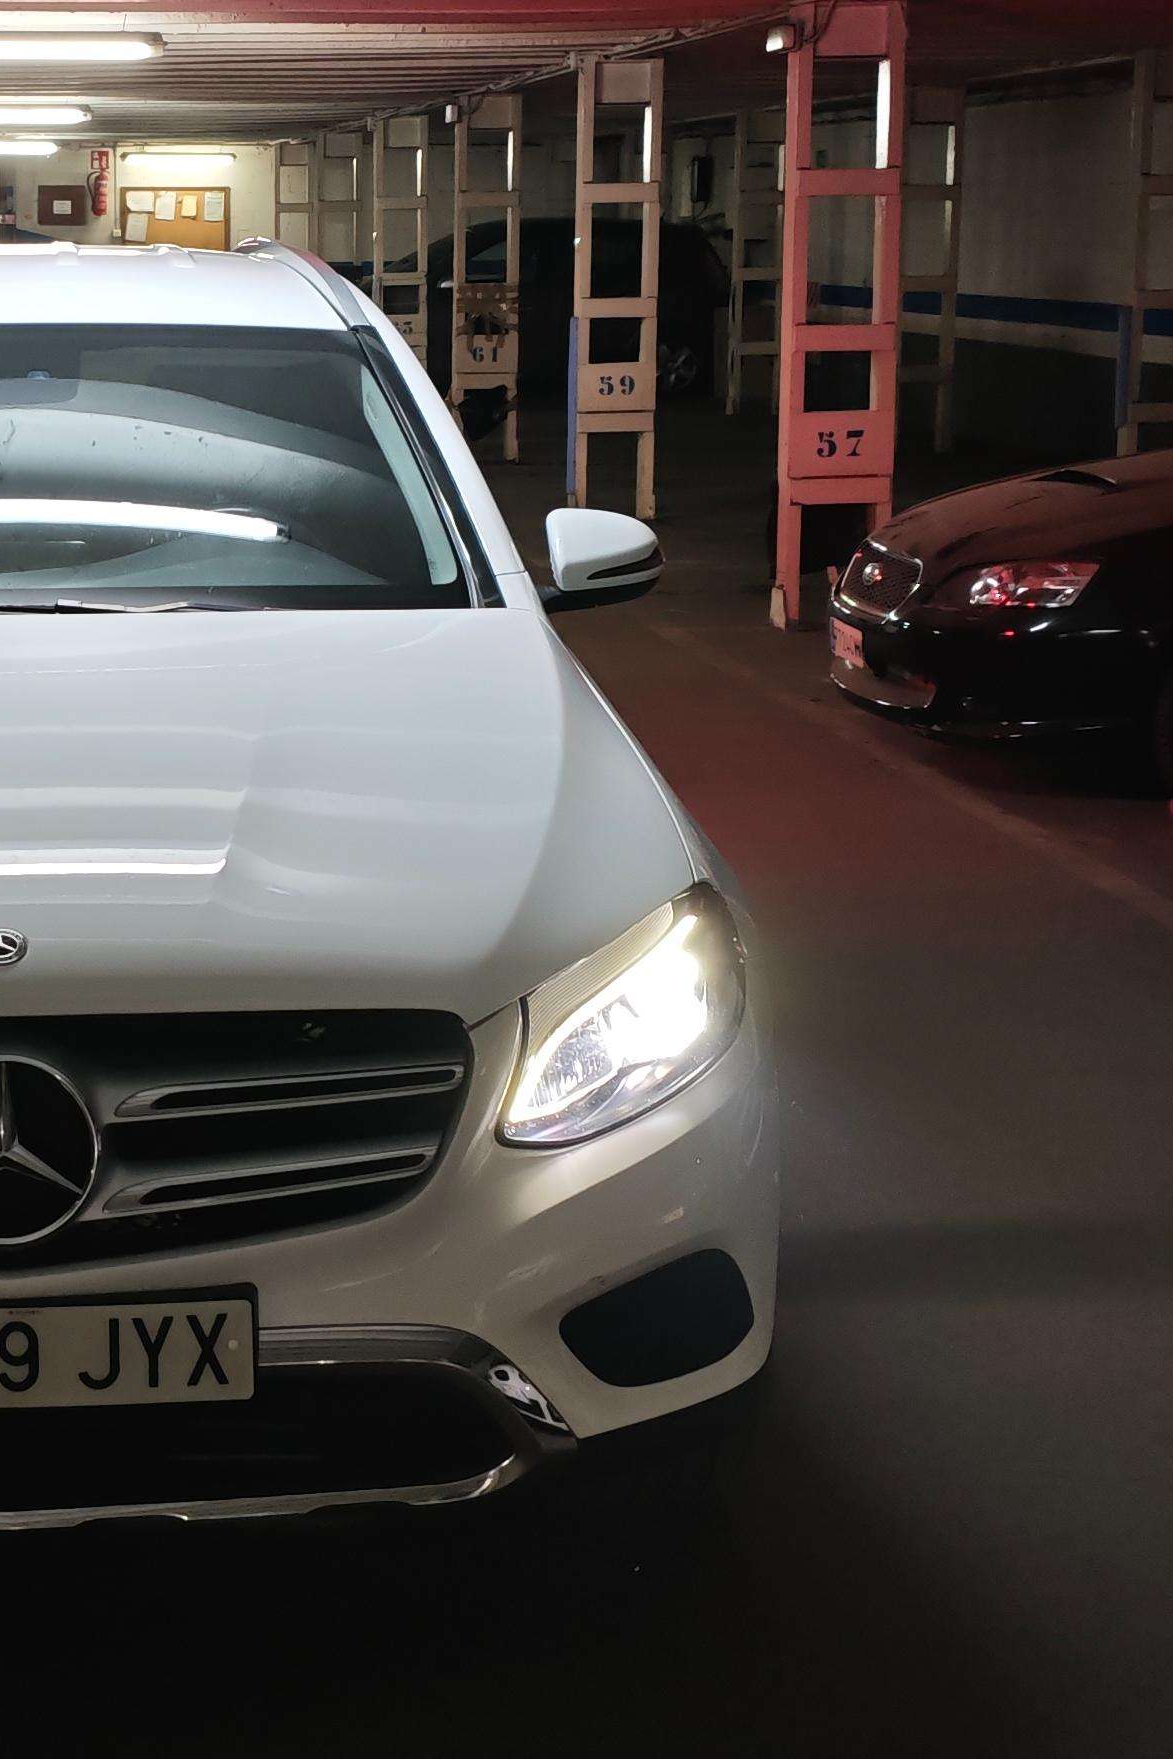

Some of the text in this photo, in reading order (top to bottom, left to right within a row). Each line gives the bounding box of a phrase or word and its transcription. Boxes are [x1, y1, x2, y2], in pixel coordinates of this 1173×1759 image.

[471, 346, 499, 362] 61
[598, 375, 636, 396] 59
[816, 430, 865, 458] 57
[78, 1313, 229, 1390] JYX
